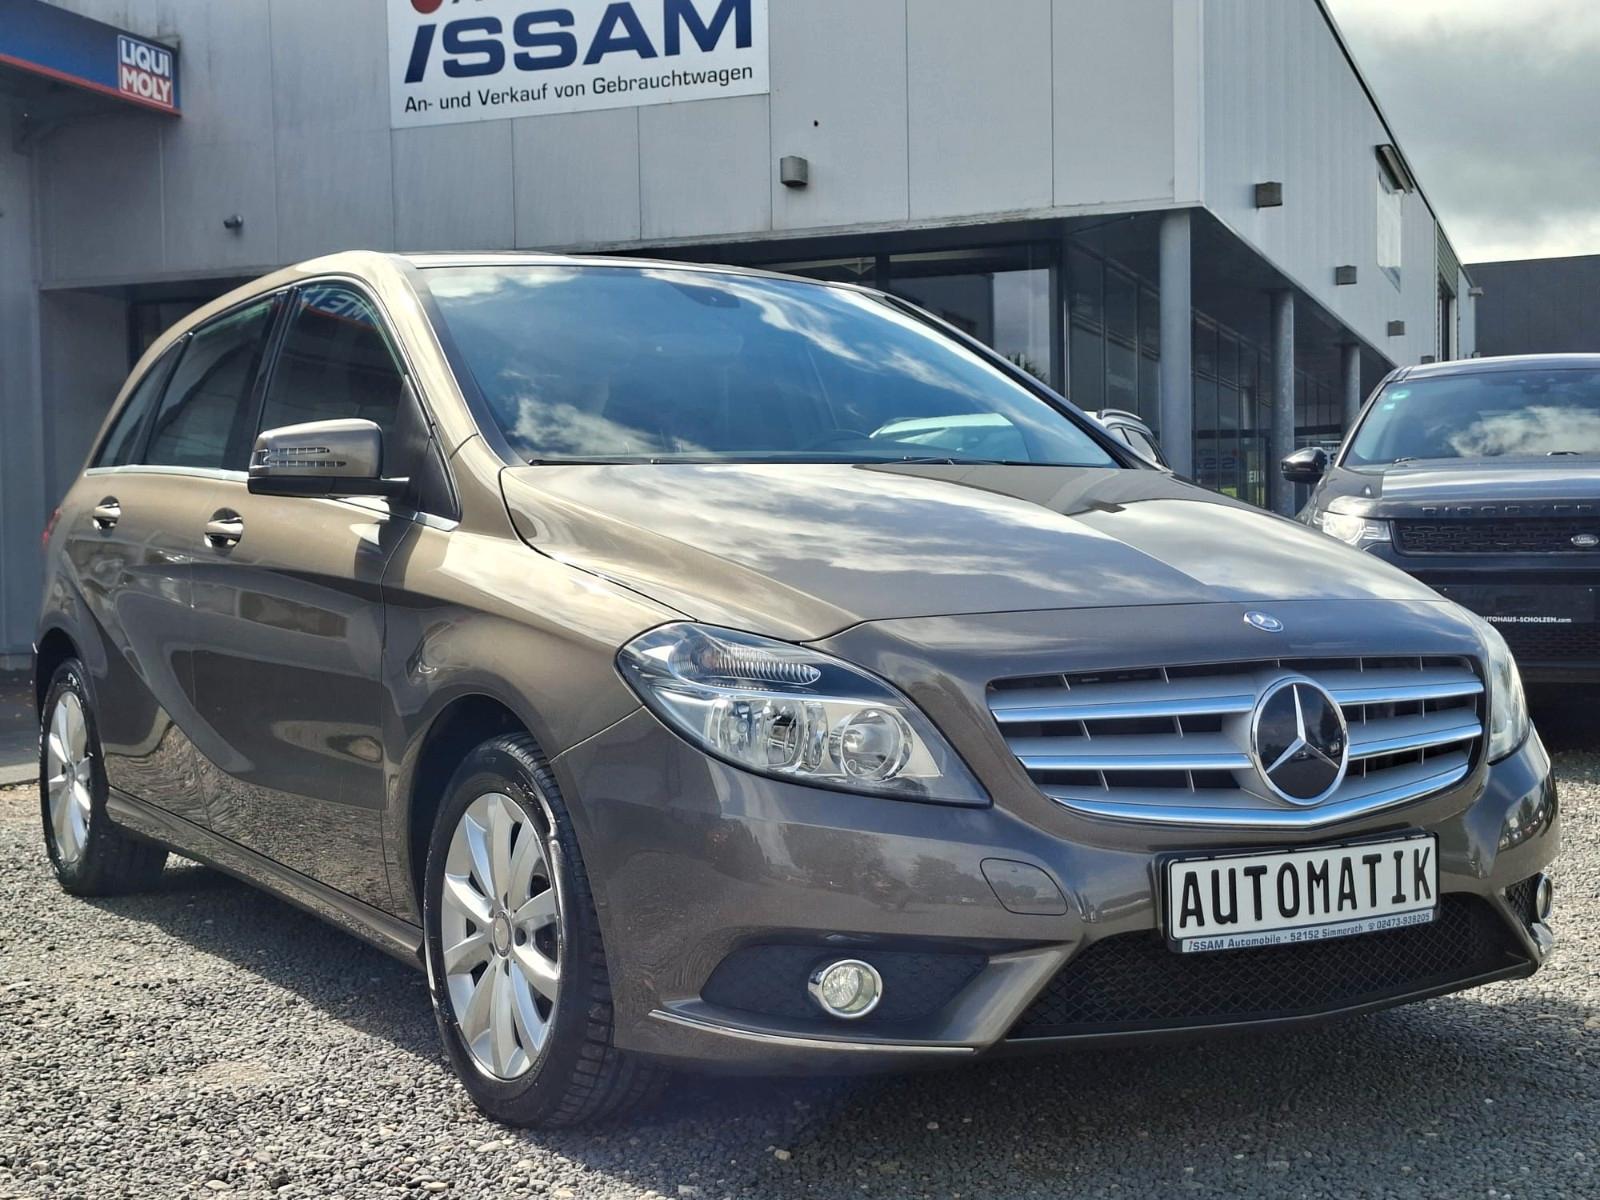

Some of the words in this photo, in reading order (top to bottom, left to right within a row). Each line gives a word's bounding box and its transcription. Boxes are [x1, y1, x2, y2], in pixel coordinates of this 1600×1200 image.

[121, 40, 169, 77] LIQUI
[122, 67, 171, 102] MOLY
[405, 96, 433, 113] An-
[439, 91, 472, 110] und
[478, 83, 549, 107] Verkauf
[554, 83, 586, 99] von
[592, 66, 753, 95] Gebrauchtwagen
[1179, 846, 1433, 929] AUTOMATIK
[1227, 934, 1281, 948] Automobile
[1290, 929, 1320, 942] 52152
[1322, 923, 1364, 938] Simmerath
